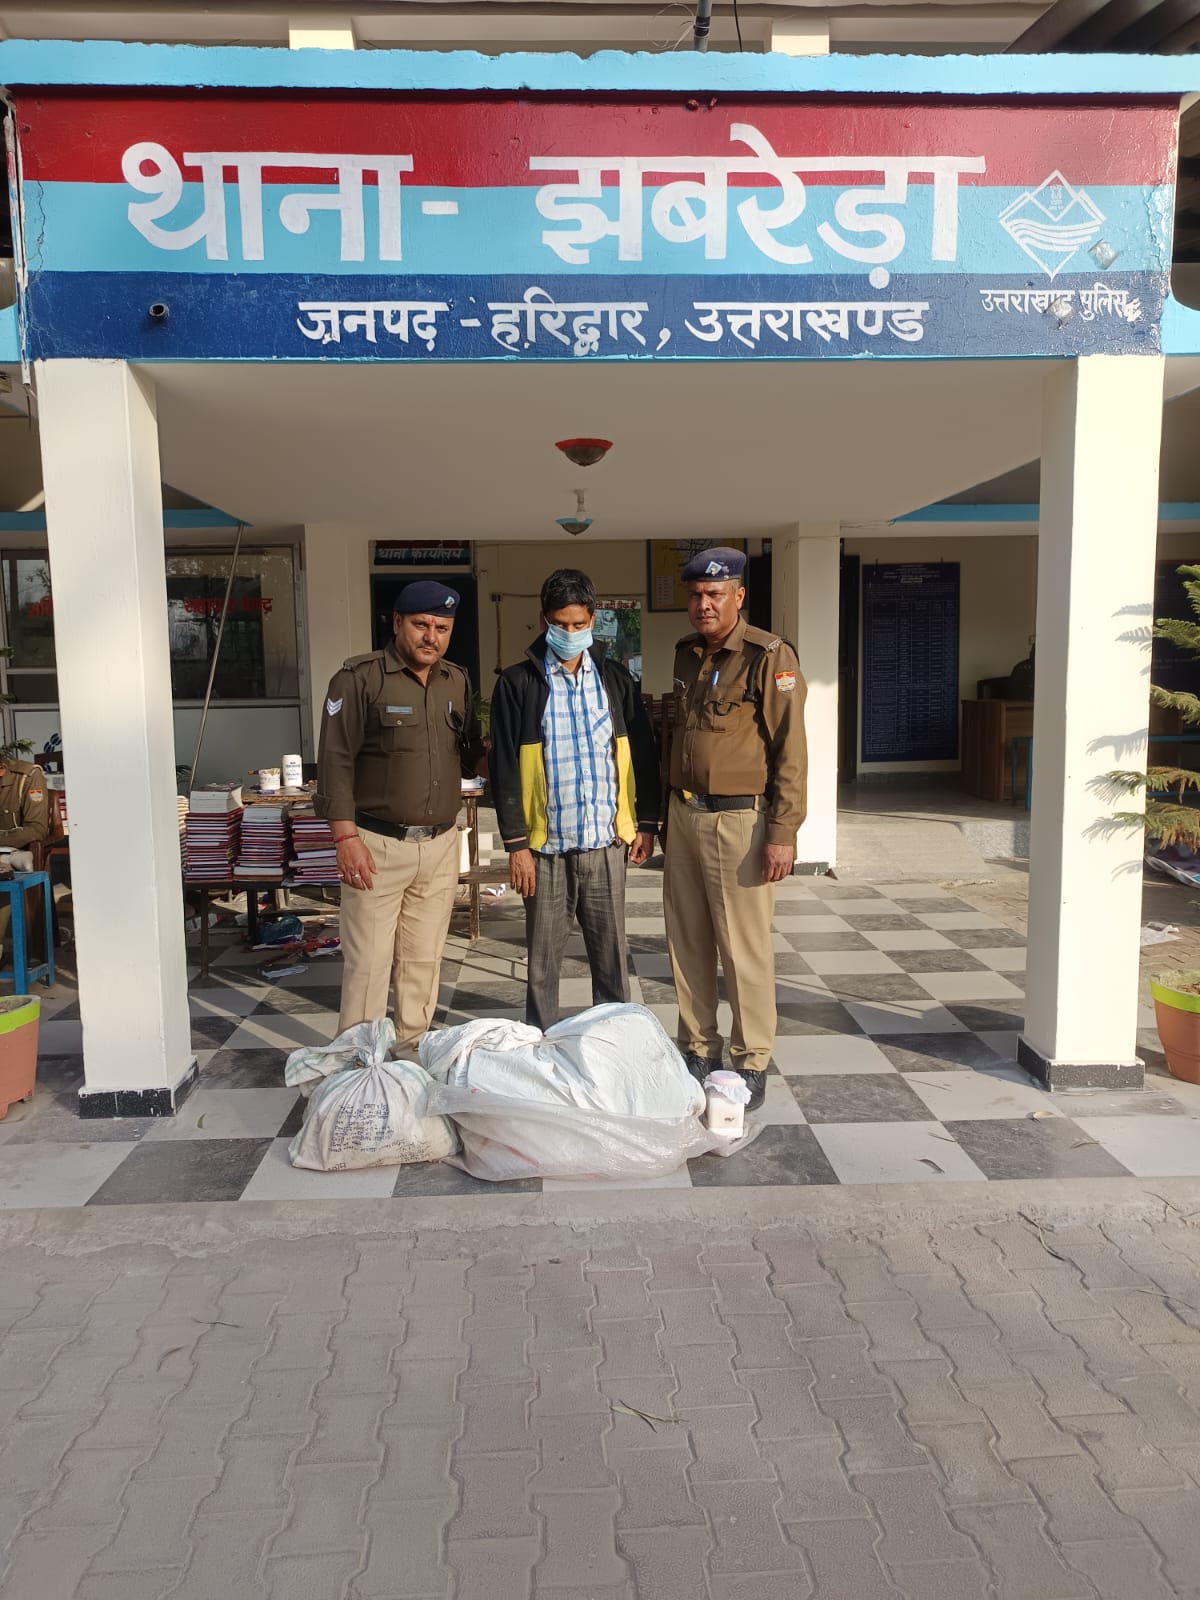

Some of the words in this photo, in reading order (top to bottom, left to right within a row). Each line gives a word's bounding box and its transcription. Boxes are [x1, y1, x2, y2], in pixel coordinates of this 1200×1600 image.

[529, 122, 986, 290] झबरेड़ा
[684, 301, 930, 349] उत्तराखण्ड
[1079, 281, 1134, 321] पुलिस
